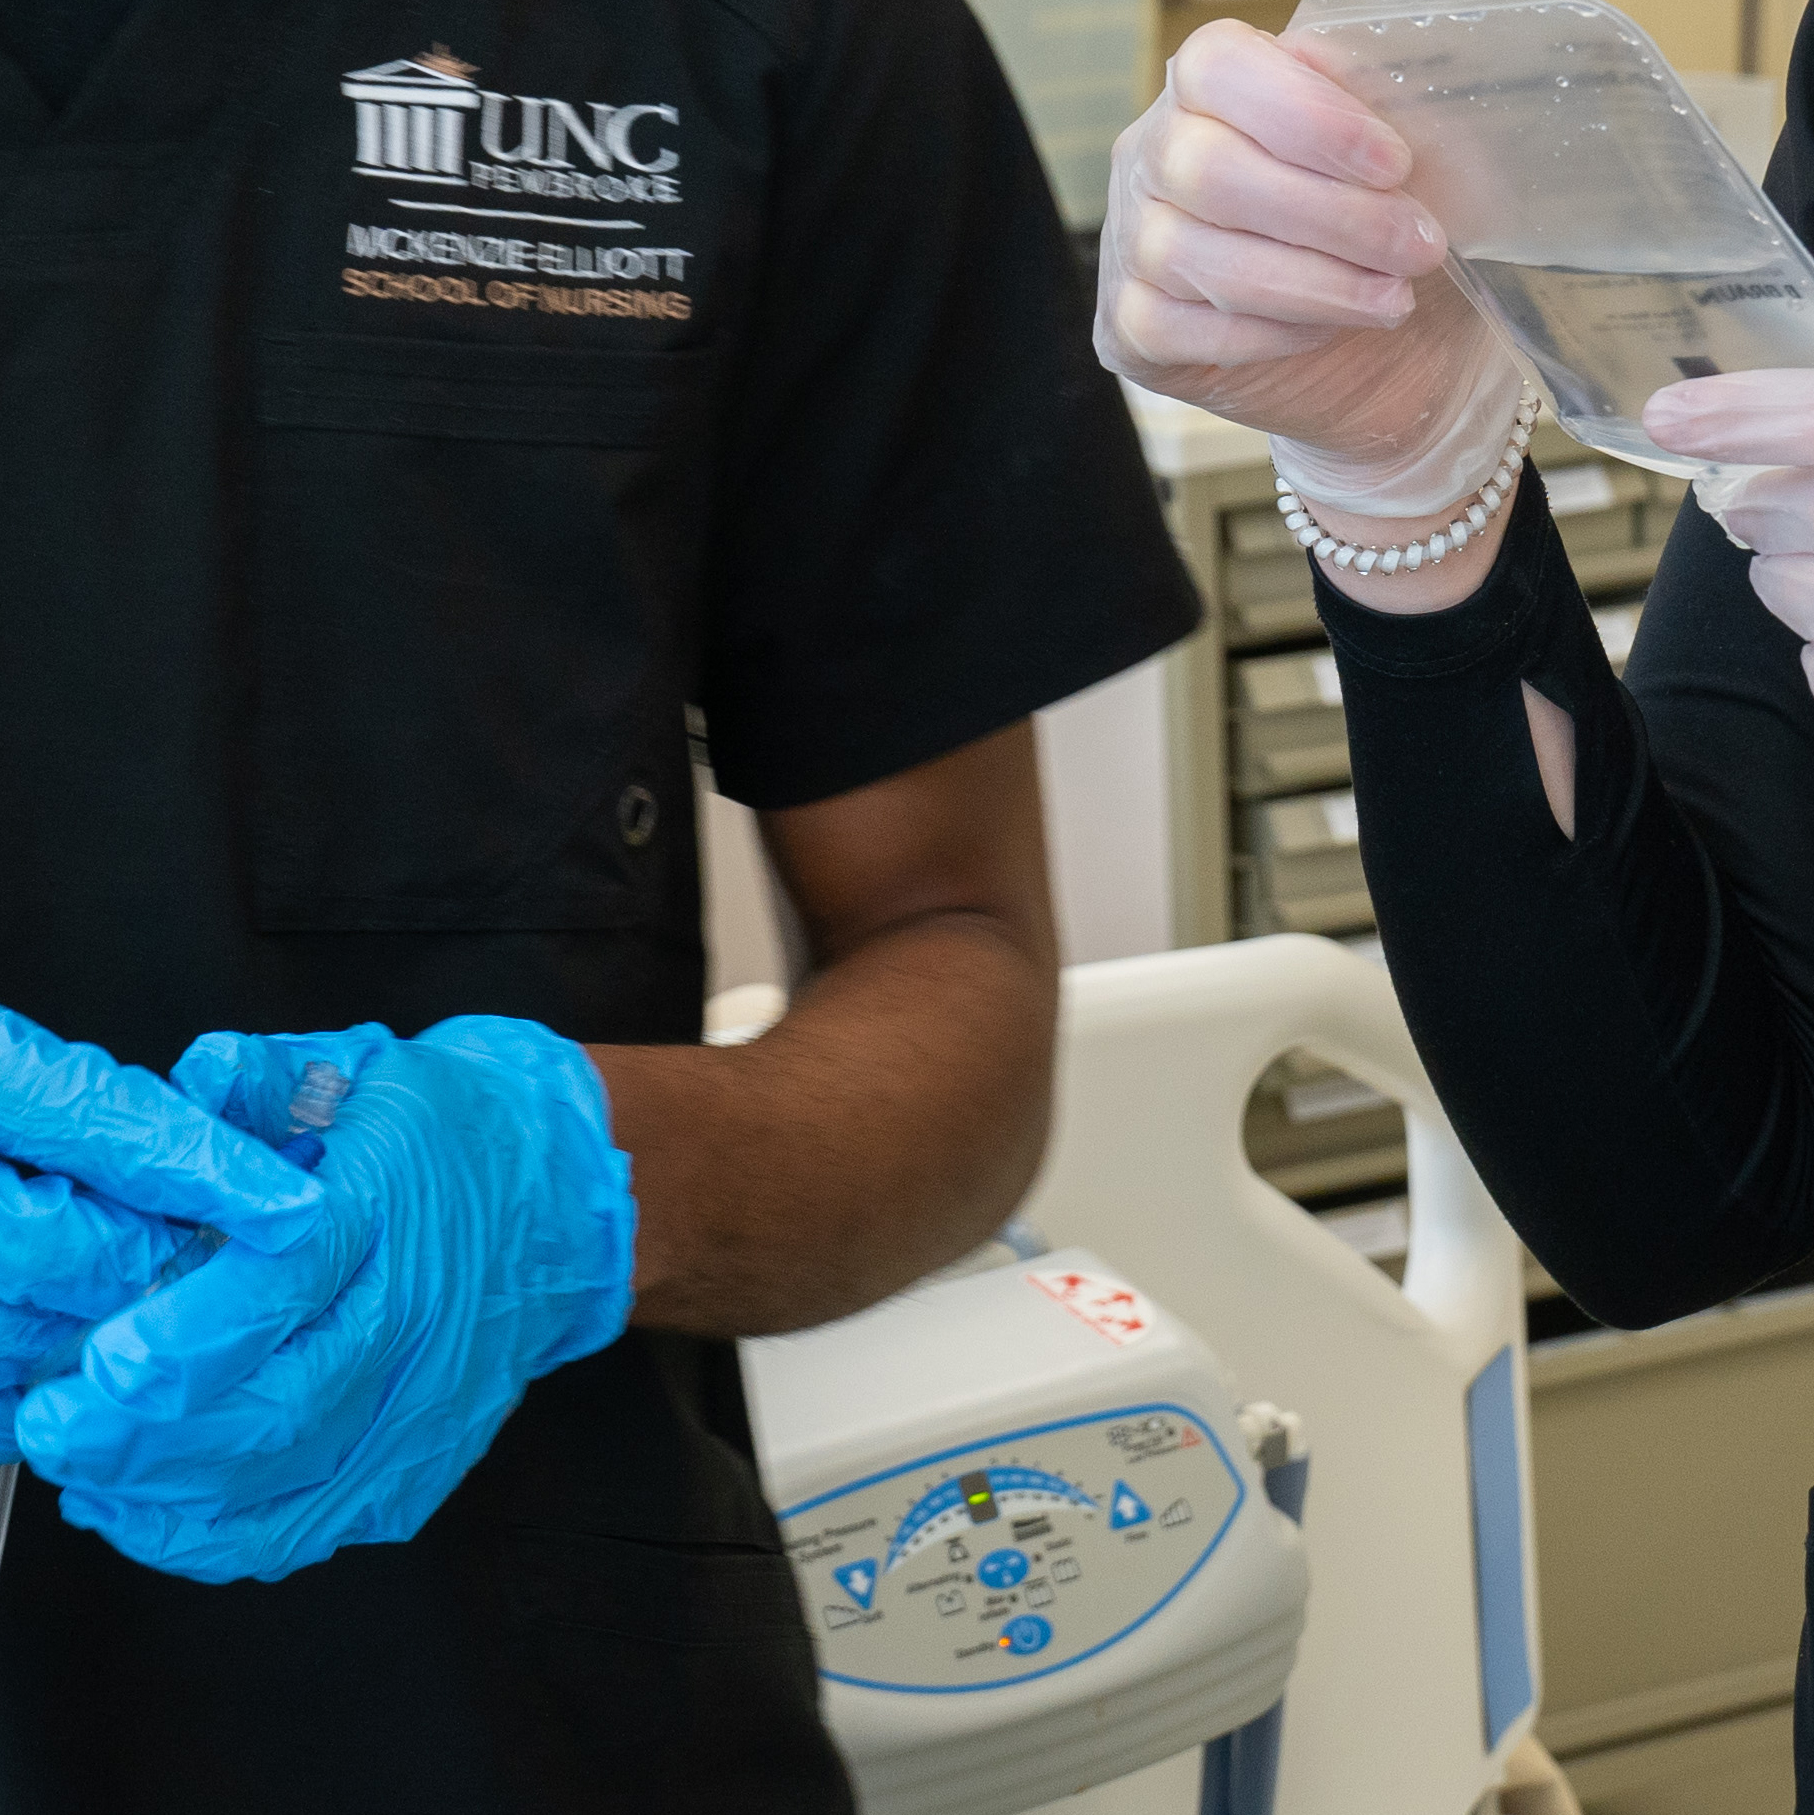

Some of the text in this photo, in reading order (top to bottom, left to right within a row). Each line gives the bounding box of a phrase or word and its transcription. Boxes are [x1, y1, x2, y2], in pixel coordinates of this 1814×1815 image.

[477, 89, 681, 173] UNC
[468, 160, 684, 203] PEMBROKE
[342, 268, 693, 320] SCHOOL OF NURSING
